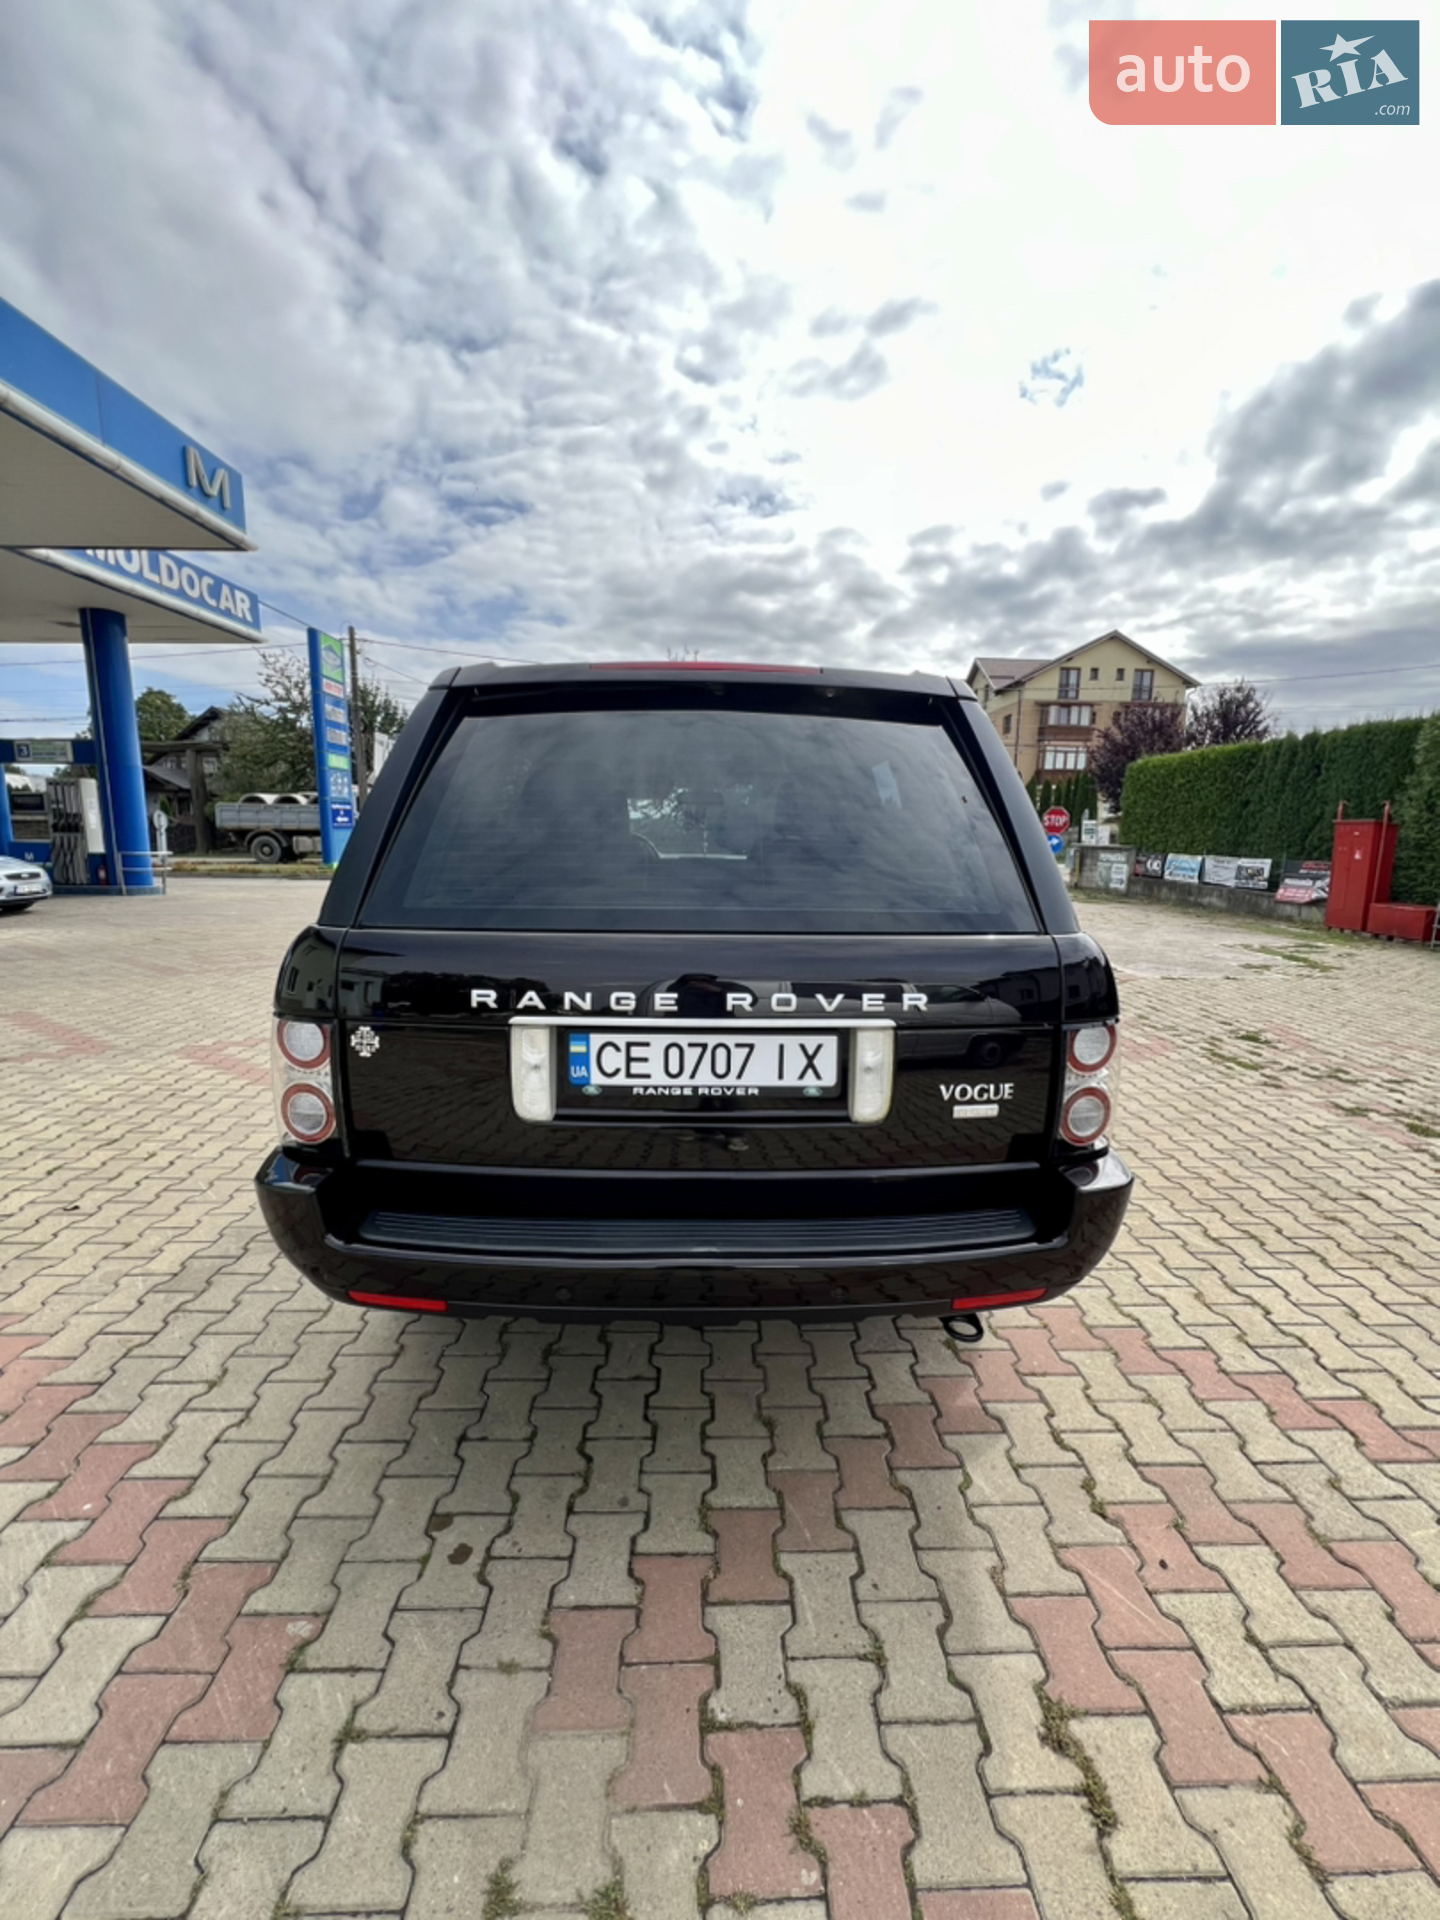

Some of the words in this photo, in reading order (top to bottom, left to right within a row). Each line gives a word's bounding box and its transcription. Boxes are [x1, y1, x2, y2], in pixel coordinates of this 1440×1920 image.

[183, 446, 231, 510] M
[1044, 814, 1067, 827] STOP
[470, 989, 679, 1011] RANGE
[726, 993, 928, 1012] ROVER
[596, 1041, 651, 1079] CE
[663, 1042, 755, 1080] 0707
[570, 1066, 588, 1077] UA
[632, 1087, 699, 1096] RANGE
[704, 1087, 760, 1096] ROVER
[939, 1083, 1014, 1101] VOGUE
